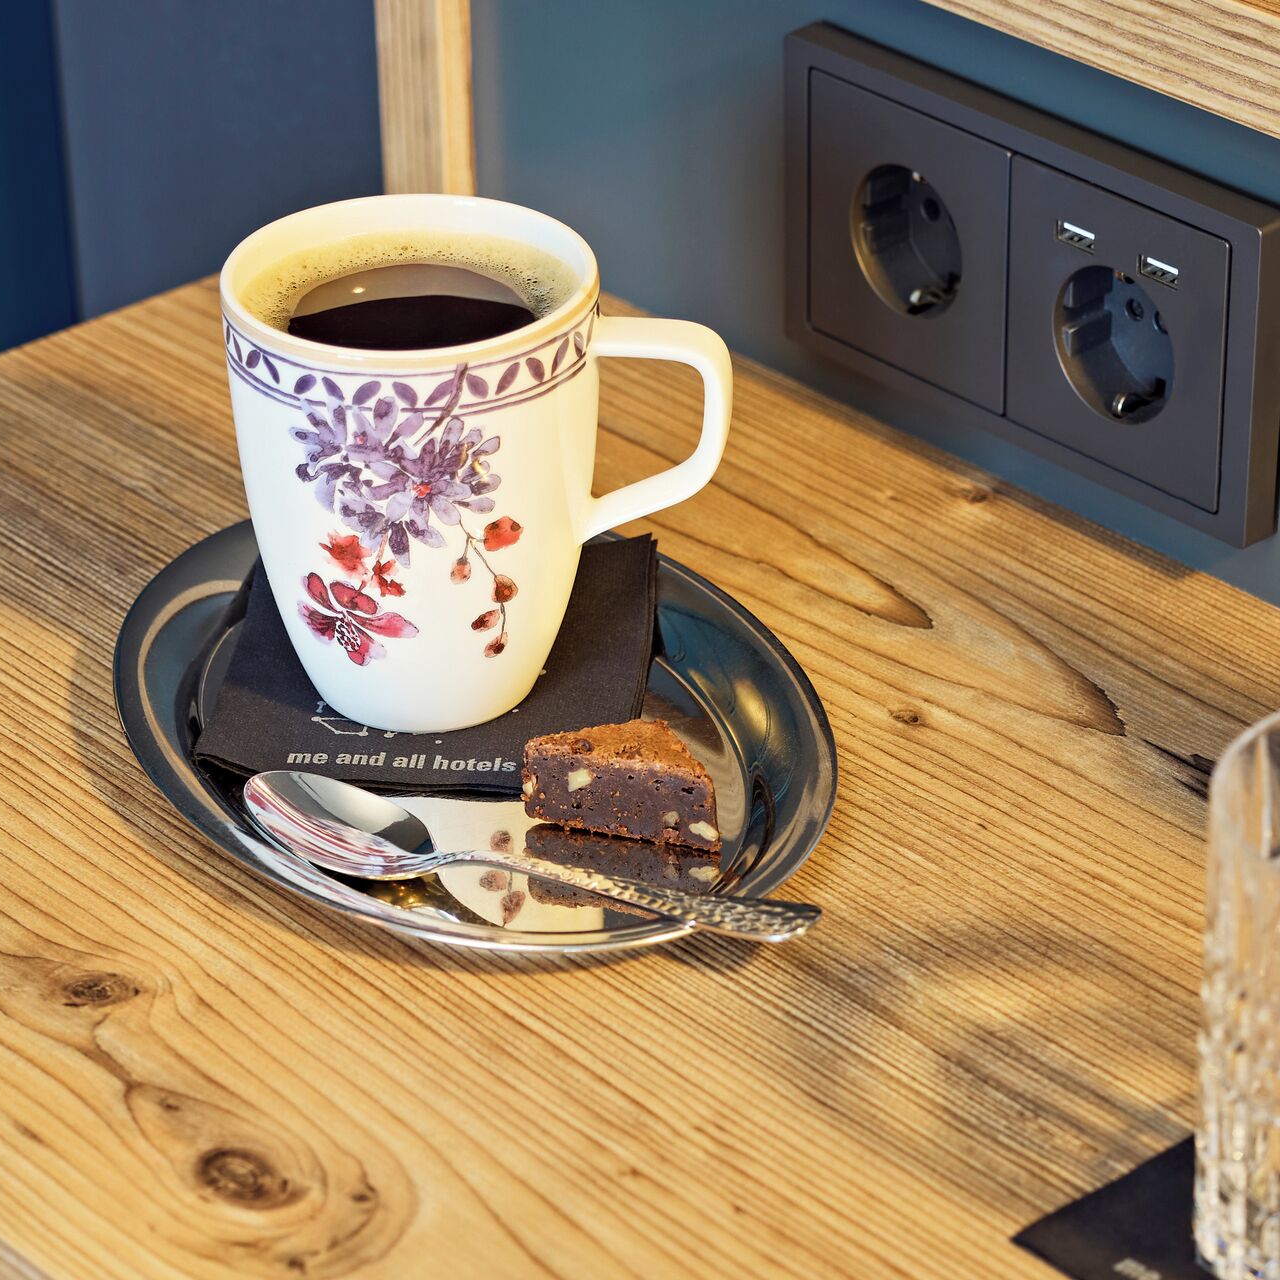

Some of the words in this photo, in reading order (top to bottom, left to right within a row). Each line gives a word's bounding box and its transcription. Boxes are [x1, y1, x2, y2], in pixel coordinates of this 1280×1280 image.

[287, 752, 329, 764] me
[335, 752, 387, 767] and
[392, 754, 424, 769] all
[432, 755, 517, 772] hotels
